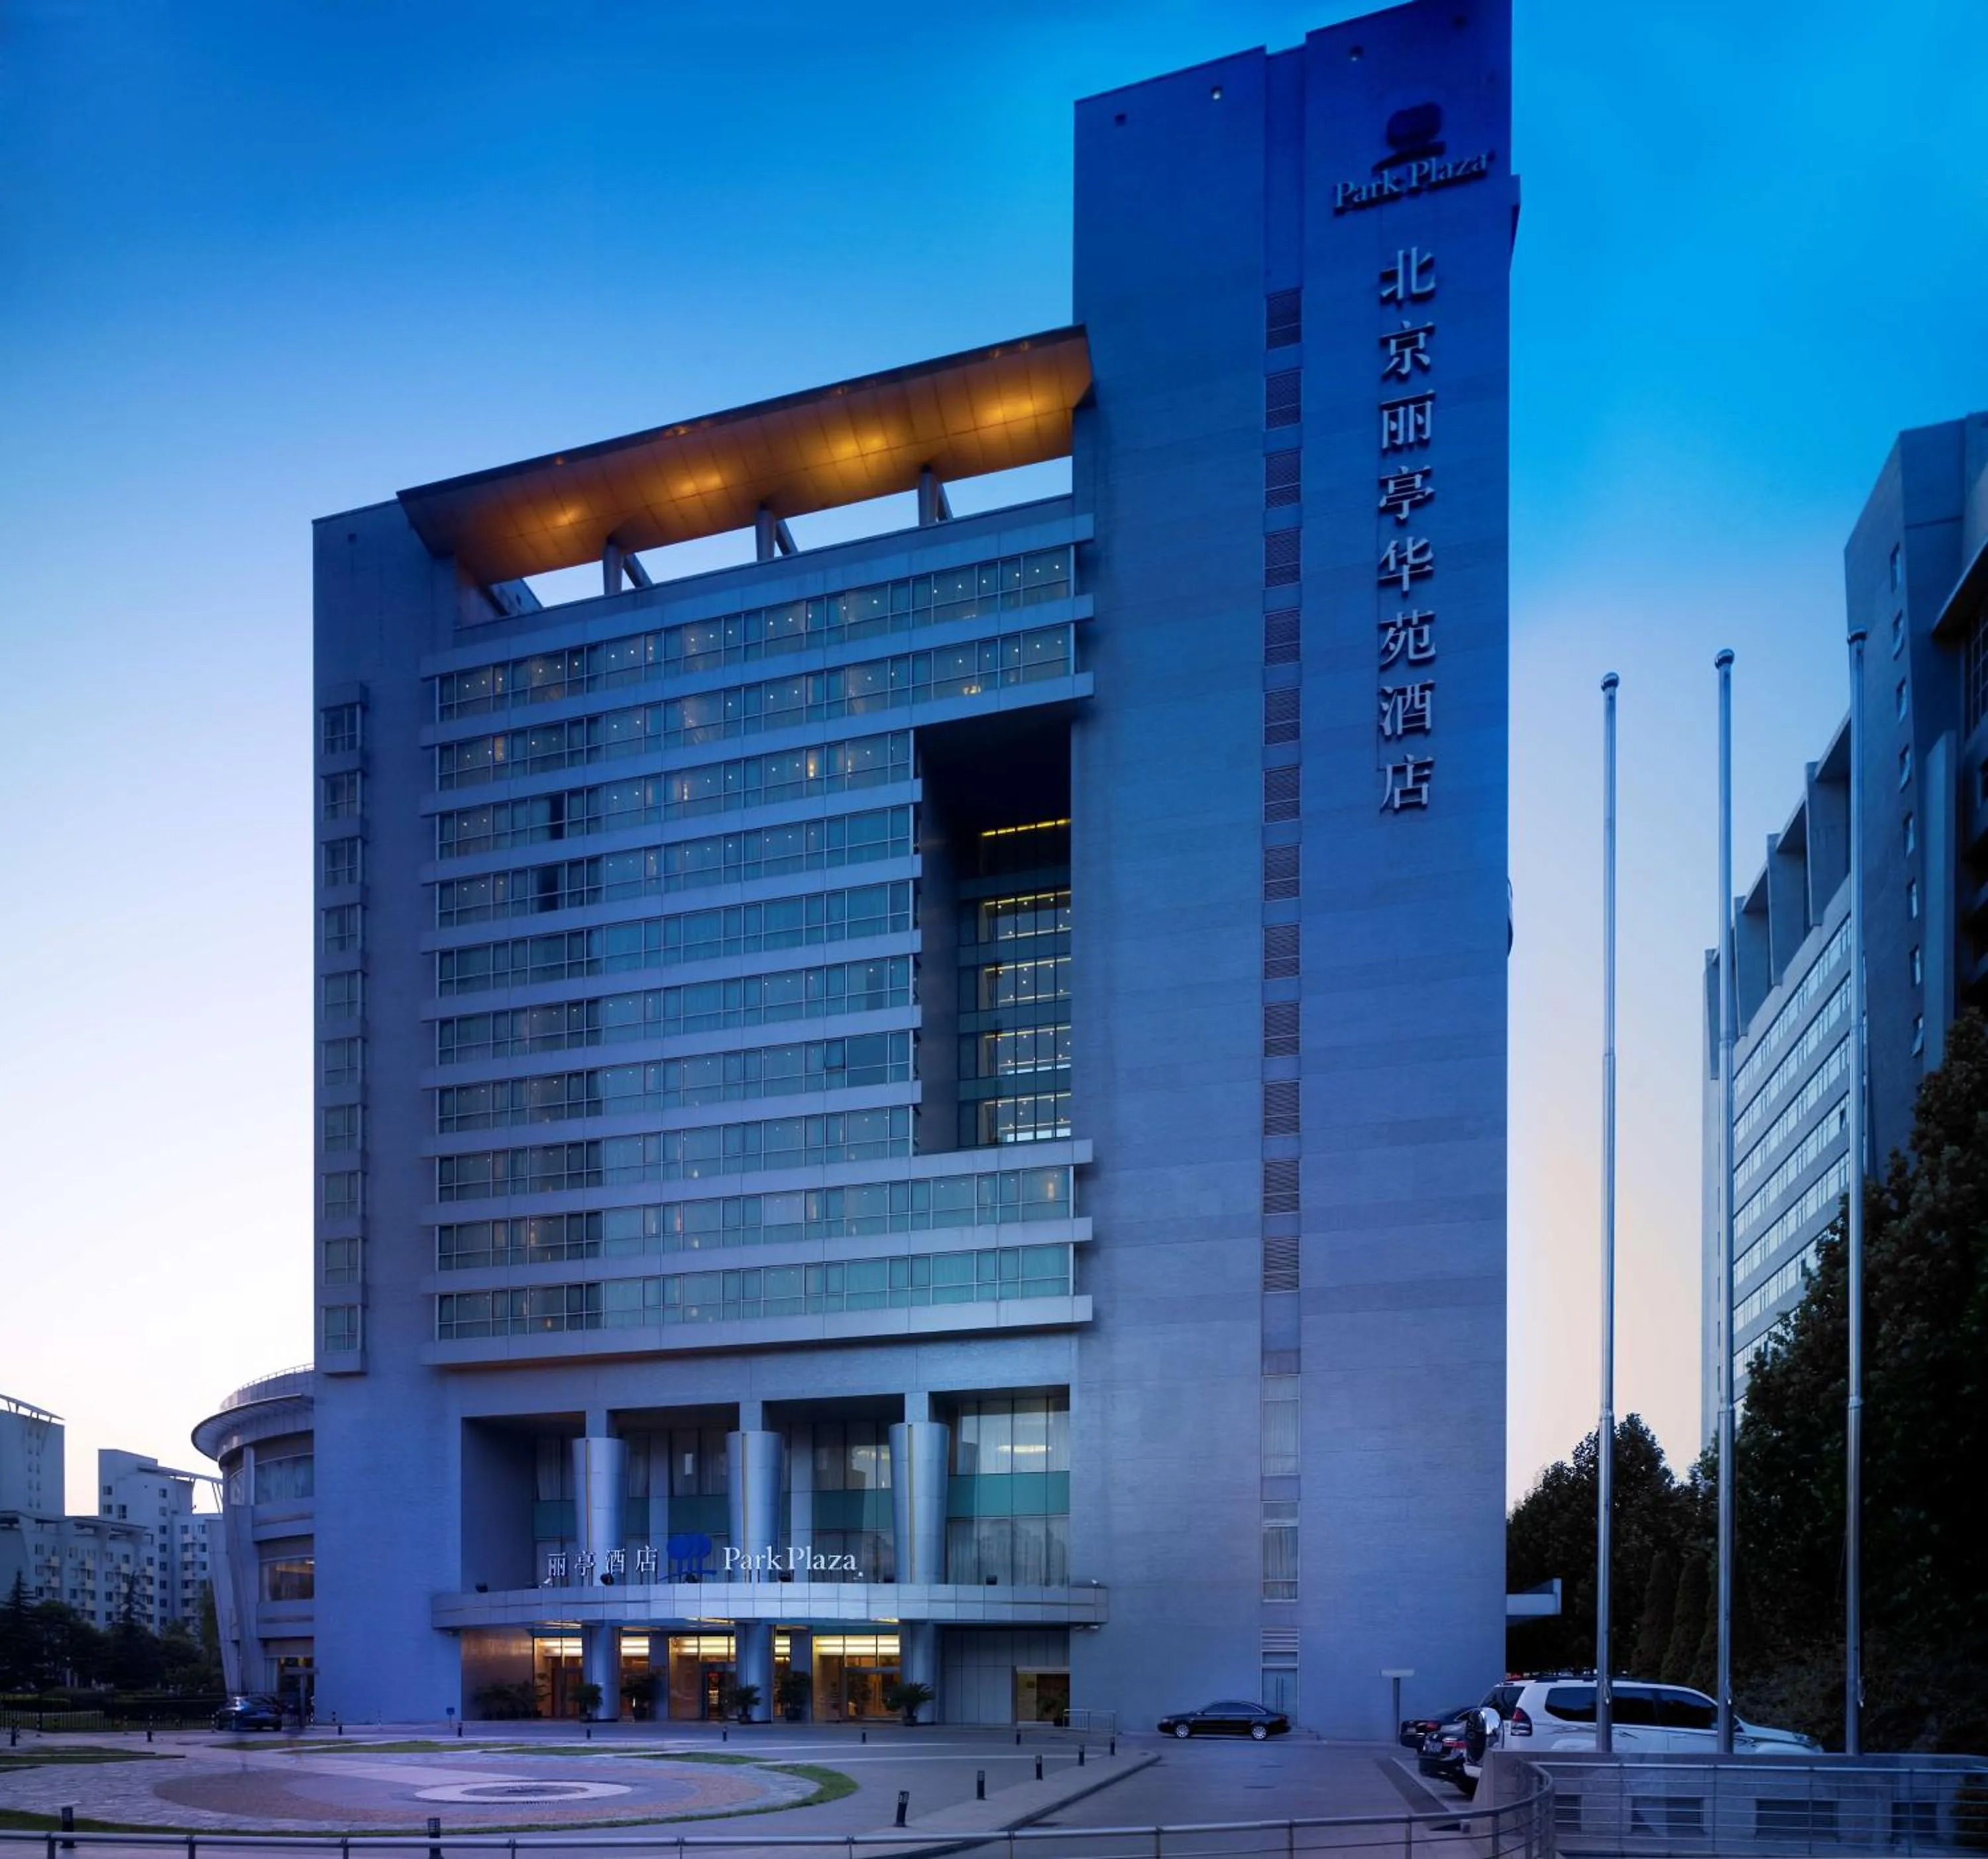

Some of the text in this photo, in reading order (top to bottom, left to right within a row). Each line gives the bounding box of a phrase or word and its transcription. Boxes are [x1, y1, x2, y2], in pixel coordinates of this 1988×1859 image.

[1336, 154, 1486, 207] Park Plaza
[1379, 247, 1436, 813] 北京丽亭华苑酒店
[547, 1545, 658, 1577] 丽亭酒店
[724, 1546, 857, 1570] Park Plaza
